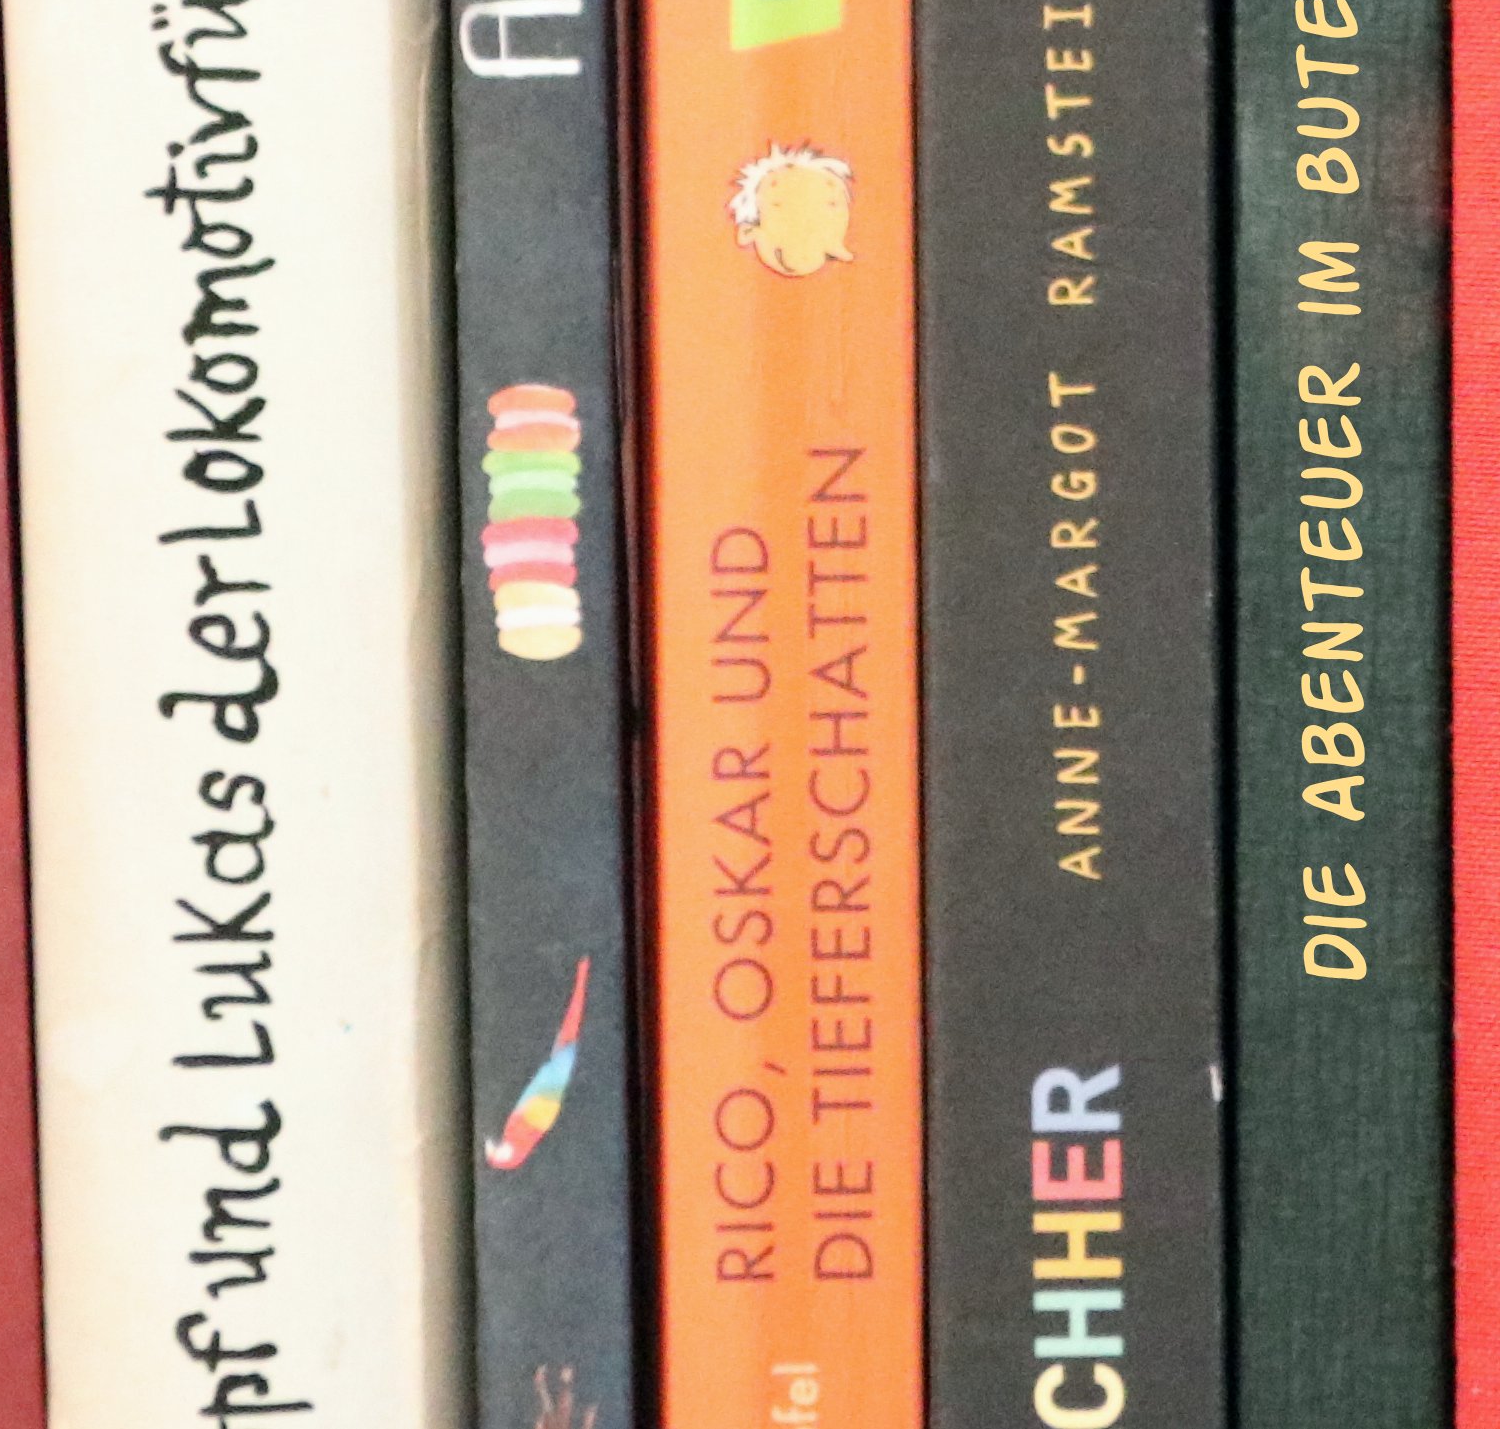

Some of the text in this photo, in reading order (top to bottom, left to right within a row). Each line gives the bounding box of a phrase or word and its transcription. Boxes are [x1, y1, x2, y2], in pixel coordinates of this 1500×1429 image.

[1297, 241, 1362, 316] IM
[157, 552, 280, 745] der
[1049, 372, 1102, 880] ANNE-MARGOT
[1297, 361, 1367, 822] ABENTEUER
[171, 770, 279, 1072] Lukas
[711, 527, 786, 1283] RICO, OSKAR UND
[806, 445, 874, 1281] DIE TIEFERSCHATTEN
[1303, 862, 1368, 981] DIE
[158, 1098, 282, 1299] und
[175, 1311, 314, 1429] pf
